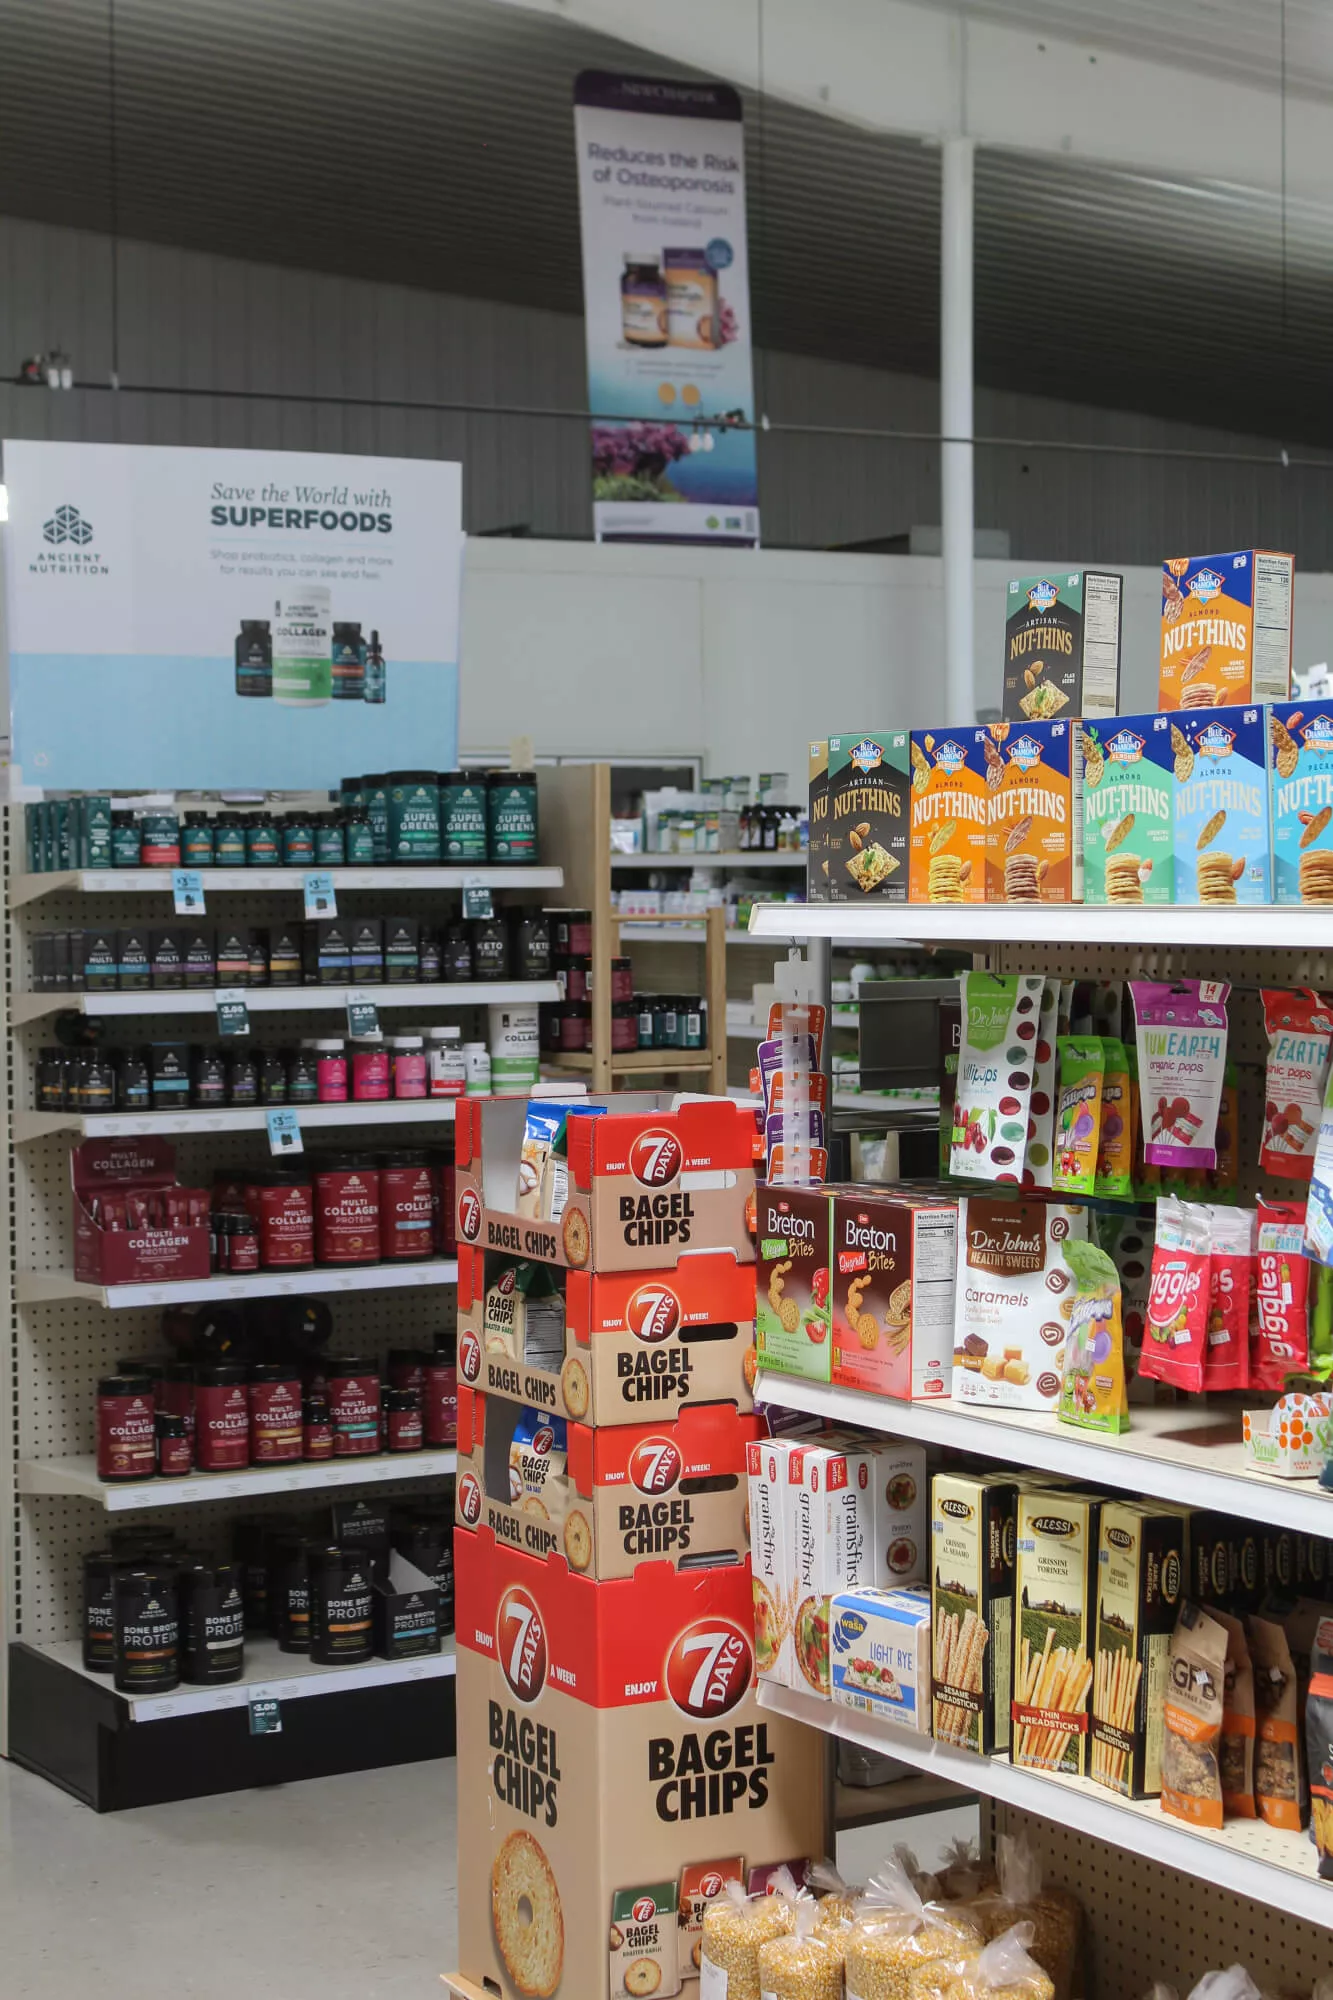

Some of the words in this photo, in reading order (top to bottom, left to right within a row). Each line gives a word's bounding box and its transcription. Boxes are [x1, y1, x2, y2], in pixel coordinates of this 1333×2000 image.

[588, 142, 665, 166] Reduces
[670, 152, 698, 170] the
[704, 153, 740, 172] Risk
[593, 166, 614, 183] of
[617, 168, 734, 195] Osteoporosis
[211, 482, 255, 500] Save
[261, 483, 289, 502] the
[294, 485, 348, 505] World
[354, 488, 392, 508] with
[211, 505, 392, 533] SUPERFOODS
[36, 552, 102, 563] ANCIENT
[210, 549, 238, 562] Shop
[300, 553, 343, 565] collagen
[347, 556, 365, 565] and
[367, 557, 393, 566] more
[29, 564, 109, 575] NUTRITION
[220, 564, 235, 573] for
[238, 565, 273, 577] results
[277, 567, 296, 577] you
[300, 568, 317, 577] can
[321, 570, 339, 578] see
[341, 569, 360, 579] and
[1189, 609, 1220, 617] ALMOND
[1025, 617, 1057, 628] ARTISAN
[277, 627, 327, 636] COLLAGEN
[1163, 618, 1246, 659] NUT-THINS
[1011, 627, 1073, 661] NUT-THINS
[1207, 727, 1224, 737] BLUE
[1313, 720, 1330, 730] BLUE
[860, 742, 873, 751] BLUE
[1018, 740, 1032, 748] BLUE
[1110, 742, 1141, 751] DIAMOND
[1118, 733, 1133, 744] BLUE
[1200, 735, 1231, 745] DIAMOND
[853, 749, 881, 758] DIAMOND
[936, 752, 963, 760] DIAMOND
[944, 744, 956, 754] BLUE
[1011, 747, 1039, 756] DIAMOND
[1112, 753, 1140, 761] ALMONDS
[1110, 774, 1141, 782] ALMOND
[1200, 768, 1233, 777] ALMOND
[849, 778, 884, 786] ARTISAN
[834, 788, 901, 820] NUT-THINS
[987, 788, 1066, 825] NUT-THINS
[1086, 784, 1169, 825] NUT-THINS
[1176, 780, 1262, 821] NUT-THINS
[404, 813, 436, 821] SUPER
[450, 814, 483, 822] SUPER
[913, 791, 985, 828] NUT-THINS
[499, 814, 532, 823] SUPER
[477, 942, 503, 950] KETO
[187, 954, 211, 962] MULTI
[1206, 983, 1217, 995] 14
[1150, 1061, 1174, 1073] organic
[1178, 1062, 1203, 1077] pops
[1287, 1068, 1312, 1080] pops
[93, 1159, 155, 1170] COLLAGEN
[606, 1162, 625, 1170] ENJOY
[639, 1136, 668, 1182] 7
[654, 1139, 677, 1179] DAYS
[691, 1158, 711, 1166] WEEK!
[341, 1199, 367, 1207] MULTI
[619, 1192, 695, 1222] BAGEL
[768, 1207, 815, 1239] Breton
[488, 1223, 521, 1252] BAGEL
[524, 1230, 557, 1258] CHIPS
[623, 1218, 691, 1246] CHIPS
[845, 1219, 896, 1252] Breton
[128, 1237, 189, 1248] COLLAGEN
[763, 1240, 787, 1255] Veggie
[788, 1238, 815, 1258] Bites
[971, 1230, 996, 1249] Dr.
[996, 1232, 1041, 1252] John's
[839, 1253, 866, 1273] Original
[867, 1251, 896, 1271] Bites
[970, 1252, 1004, 1267] HEALTHY
[1006, 1254, 1040, 1269] SWEETS
[965, 1288, 1029, 1307] Caramels
[1258, 1255, 1293, 1357] giggles
[602, 1319, 622, 1327] ENJOY
[636, 1292, 666, 1337] 7
[652, 1295, 674, 1335] DAYS
[689, 1312, 709, 1321] WEEK!
[617, 1348, 693, 1378] BAGEL
[488, 1363, 521, 1395] BAGEL
[524, 1377, 556, 1407] CHIPS
[621, 1374, 690, 1402] CHIPS
[330, 1406, 377, 1415] COLLAGEN
[521, 1455, 550, 1472] BAGEL
[605, 1472, 625, 1481] ENJOY
[637, 1444, 667, 1489] 7
[654, 1448, 676, 1488] DAYS
[691, 1464, 711, 1472] WEEK!
[522, 1468, 546, 1485] CHIPS
[618, 1499, 694, 1530] BAGEL
[944, 1501, 969, 1515] ALESSI
[343, 1525, 385, 1536] PROTEIN
[488, 1508, 521, 1541] BAGEL
[524, 1522, 558, 1553] CHIPS
[758, 1483, 776, 1576] grainsfirst
[1035, 1519, 1071, 1532] ALESSI
[623, 1526, 691, 1555] CHIPS
[800, 1493, 815, 1587] grainsfirst
[842, 1494, 863, 1587] grainsfirst
[1110, 1530, 1131, 1545] ALESSI
[1037, 1565, 1068, 1576] TORINESI
[1038, 1557, 1068, 1567] GRISSINI
[1168, 1559, 1178, 1595] ALESSI
[327, 1600, 353, 1608] BONE
[205, 1617, 230, 1625] BONE
[394, 1618, 435, 1630] PROTEIN
[841, 1619, 864, 1632] wasa
[124, 1626, 149, 1634] BONE
[475, 1629, 494, 1649] ENJOY
[505, 1601, 534, 1688] 7
[519, 1615, 544, 1689] DAYS
[870, 1642, 893, 1664] LIGHT
[897, 1649, 912, 1670] RYE
[556, 1667, 577, 1688] WEEK!
[624, 1680, 658, 1697] ENJOY
[681, 1631, 730, 1709] 7
[707, 1634, 745, 1705] DAYS
[1172, 1657, 1216, 1700] GFB
[943, 1685, 970, 1699] SESAME
[936, 1692, 979, 1711] BREADSTICKS
[1020, 1715, 1080, 1731] BREADSTICKS
[1039, 1710, 1060, 1720] THIN
[487, 1699, 562, 1781] BAGEL
[1103, 1725, 1122, 1739] GARLIC
[1095, 1731, 1130, 1751] BREADSTICKS
[648, 1722, 775, 1782] BAGEL
[493, 1752, 559, 1829] CHIPS
[655, 1767, 770, 1824] CHIPS
[626, 1924, 660, 1939] BAGEL
[628, 1934, 658, 1948] CHIPS
